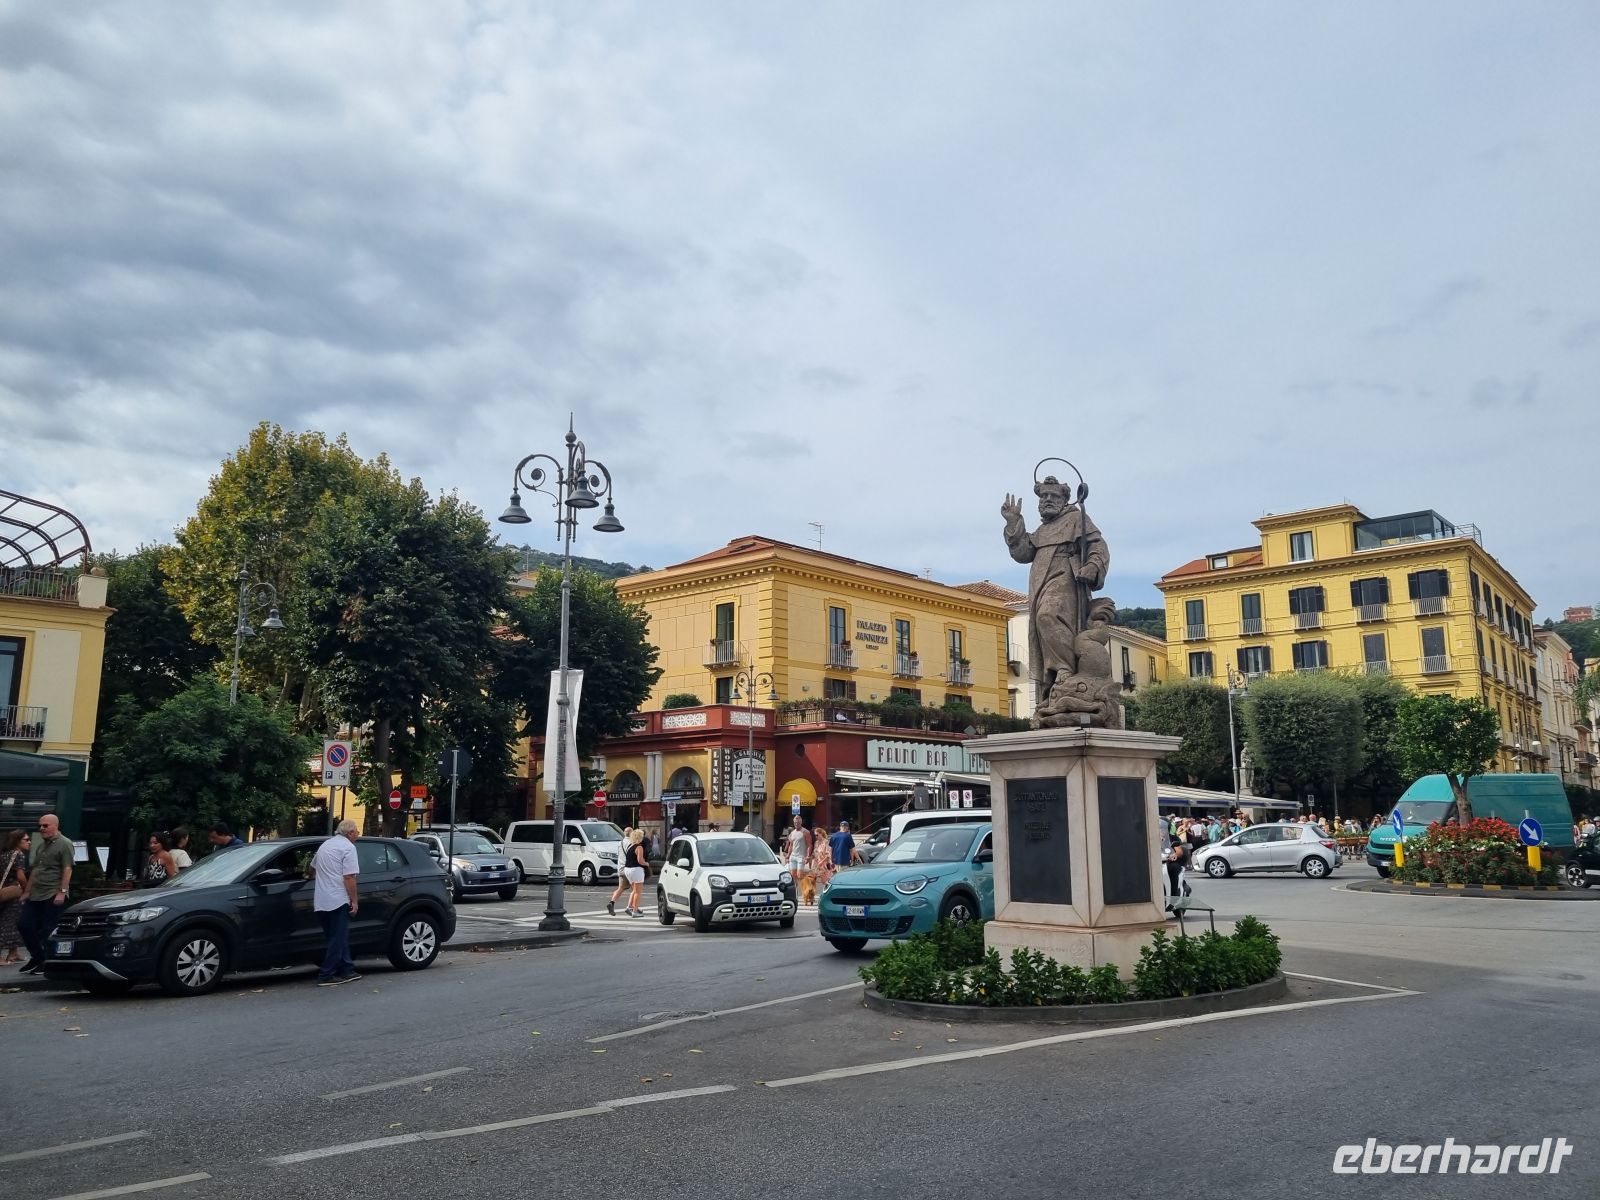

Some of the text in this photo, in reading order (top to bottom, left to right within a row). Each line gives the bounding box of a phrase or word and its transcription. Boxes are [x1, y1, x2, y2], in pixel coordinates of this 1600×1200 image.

[878, 746, 949, 767] FAUNO BAR
[712, 751, 720, 801] LINENS
